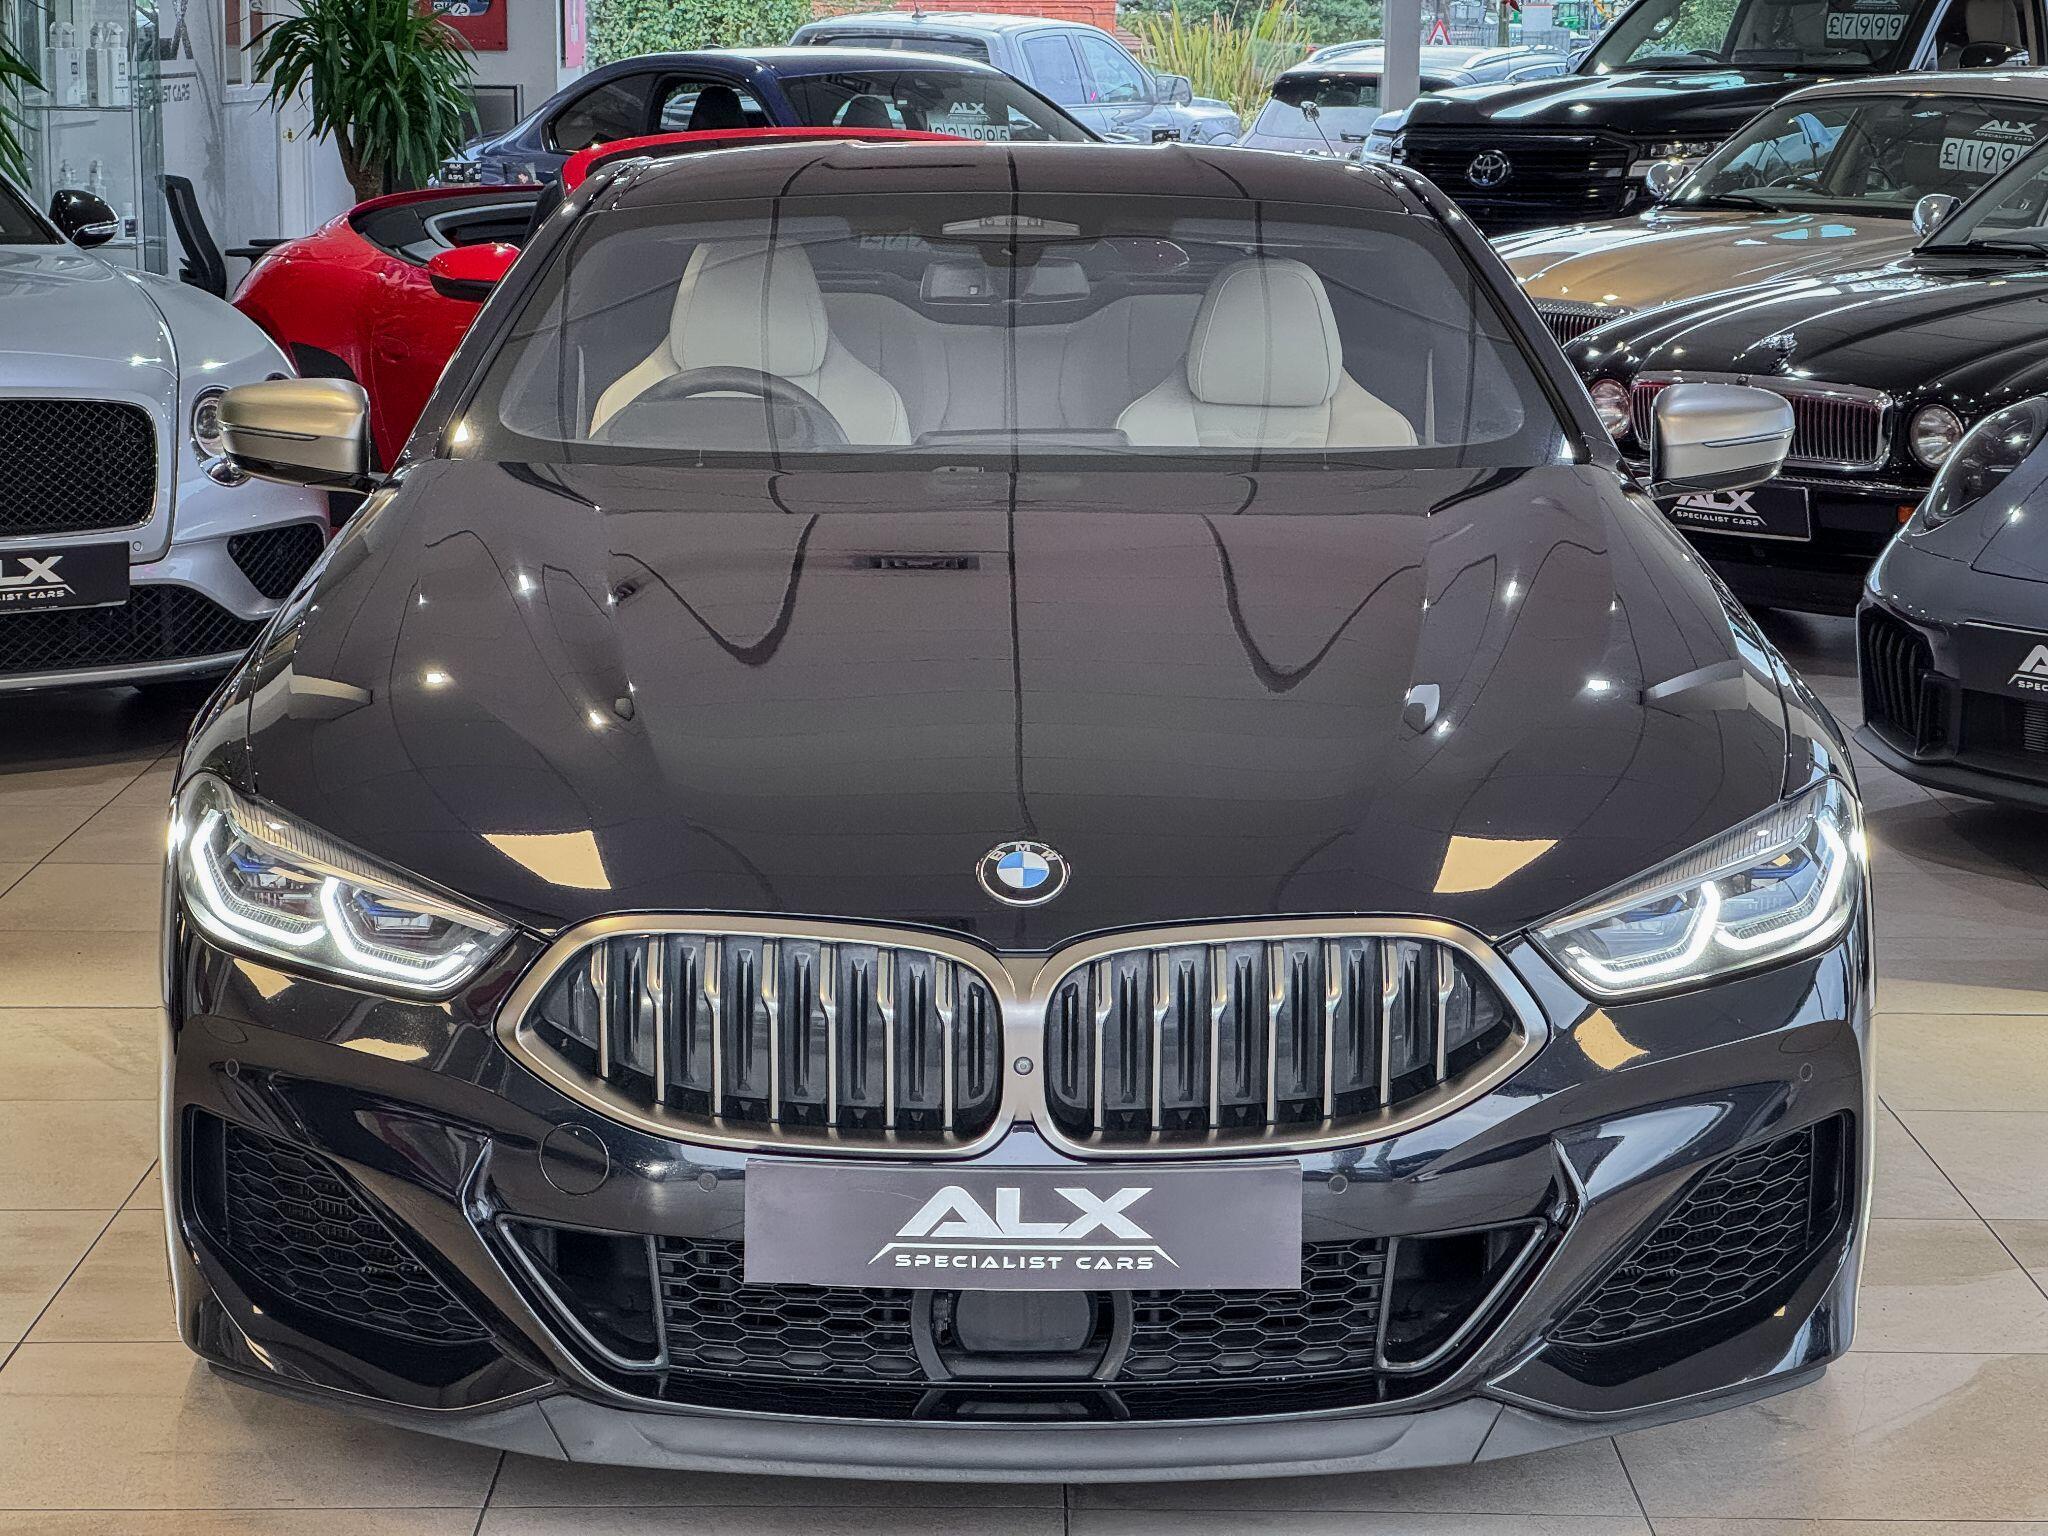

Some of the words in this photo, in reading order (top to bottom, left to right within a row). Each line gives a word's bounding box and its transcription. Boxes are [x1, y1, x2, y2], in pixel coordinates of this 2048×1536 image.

[949, 102, 986, 115] ALX
[1979, 119, 2037, 135] ALX
[1676, 511, 1730, 523] SPECIALIST
[1732, 517, 1759, 526] CARS
[28, 590, 65, 599] CARS
[989, 843, 1058, 861] BMW
[896, 1185, 1153, 1239] ALX
[895, 1254, 1063, 1270] SPECIALIST
[1076, 1256, 1154, 1270] CARS
